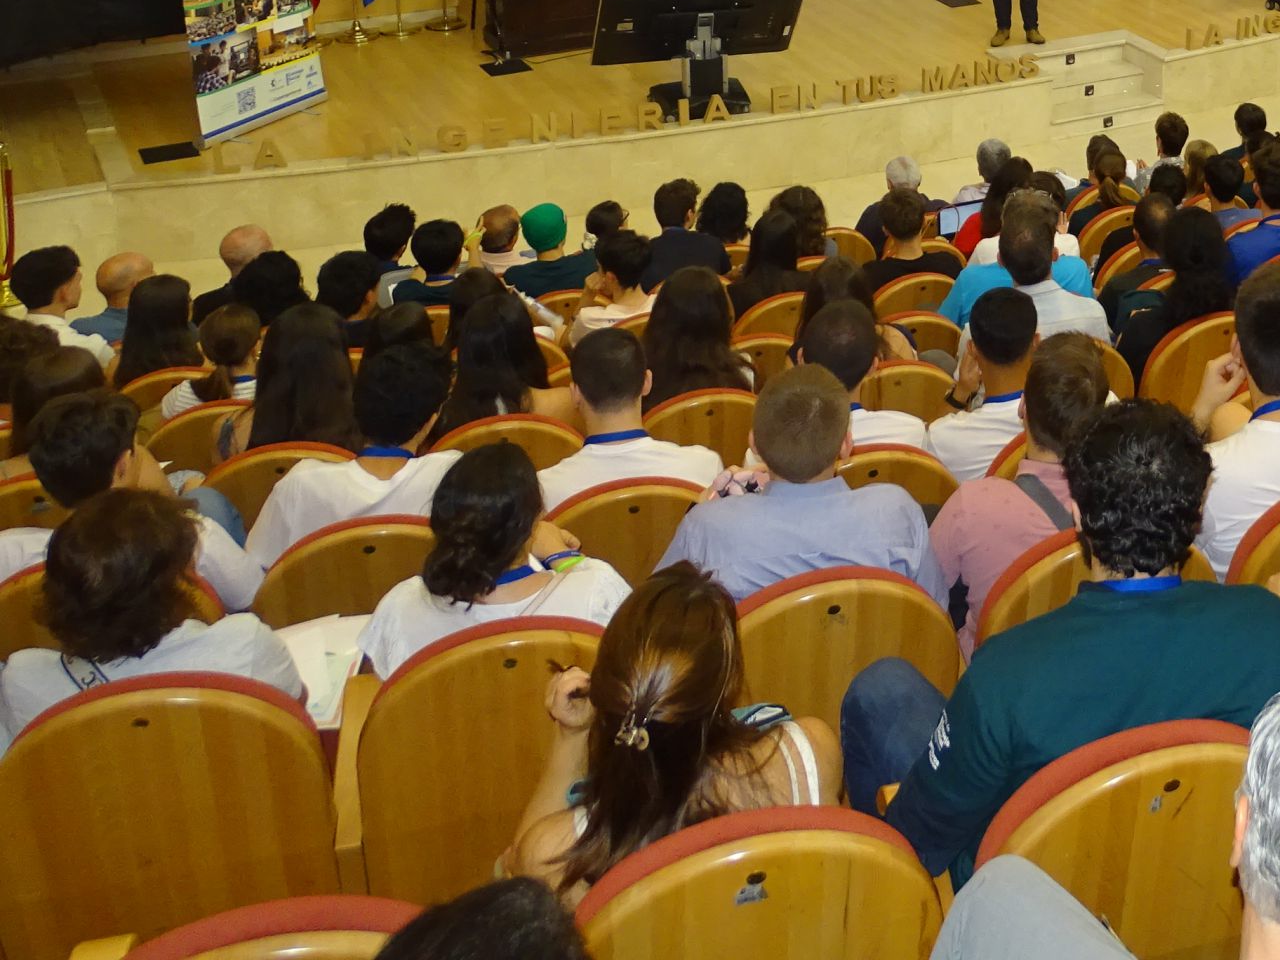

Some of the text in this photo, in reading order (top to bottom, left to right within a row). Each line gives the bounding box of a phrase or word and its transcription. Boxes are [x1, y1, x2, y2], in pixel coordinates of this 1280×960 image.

[1185, 23, 1224, 51] LA
[213, 138, 288, 175] LA
[770, 80, 821, 115] EN
[834, 73, 897, 106] TUS
[921, 53, 1041, 95] MANOS
